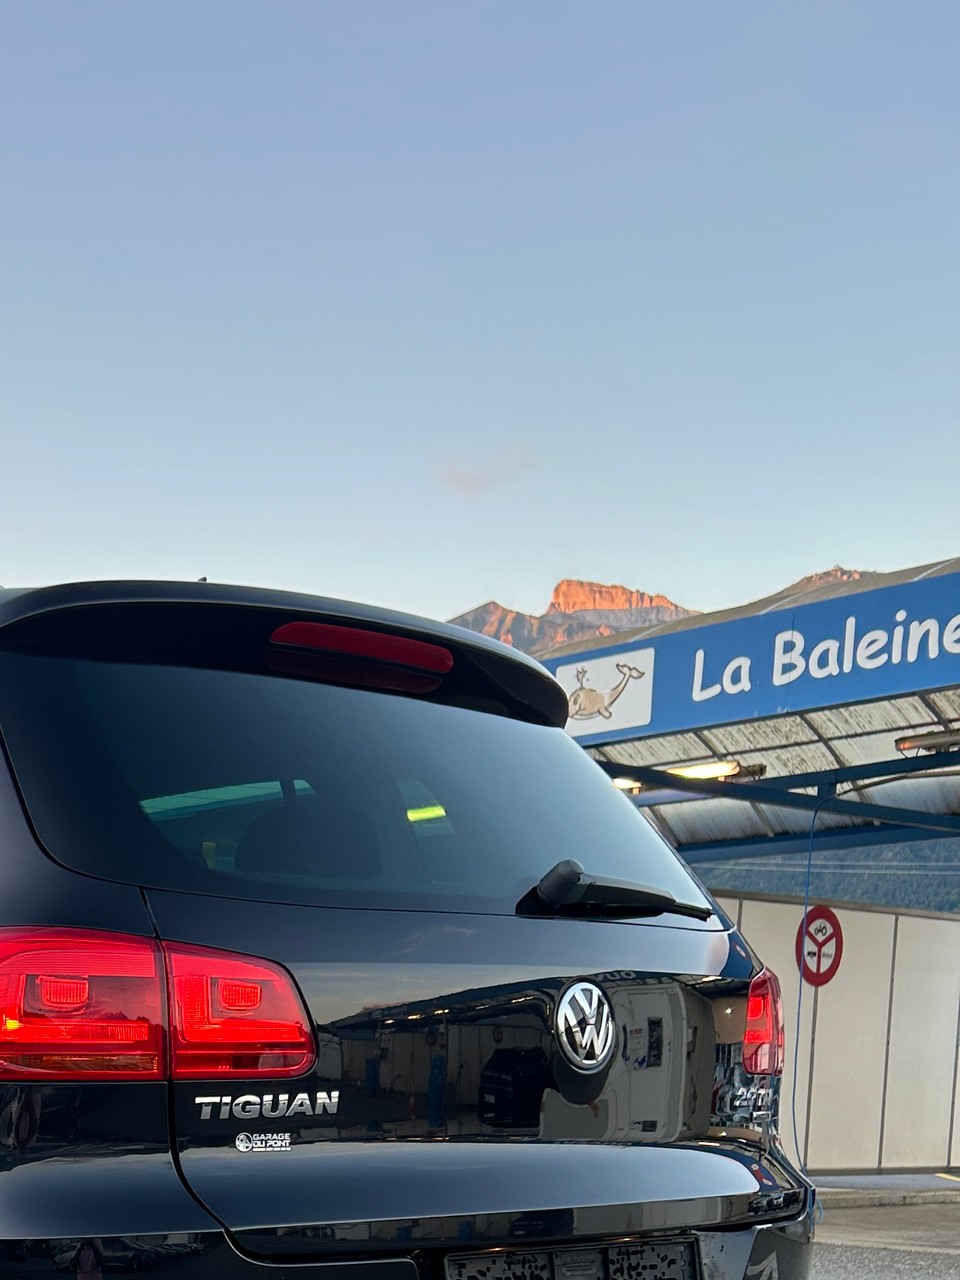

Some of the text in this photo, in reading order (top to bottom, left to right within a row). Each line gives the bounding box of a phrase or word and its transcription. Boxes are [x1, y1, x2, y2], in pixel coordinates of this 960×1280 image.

[692, 609, 960, 702] La Baleine
[195, 1091, 340, 1120] TIGUAN
[252, 1140, 265, 1148] DU
